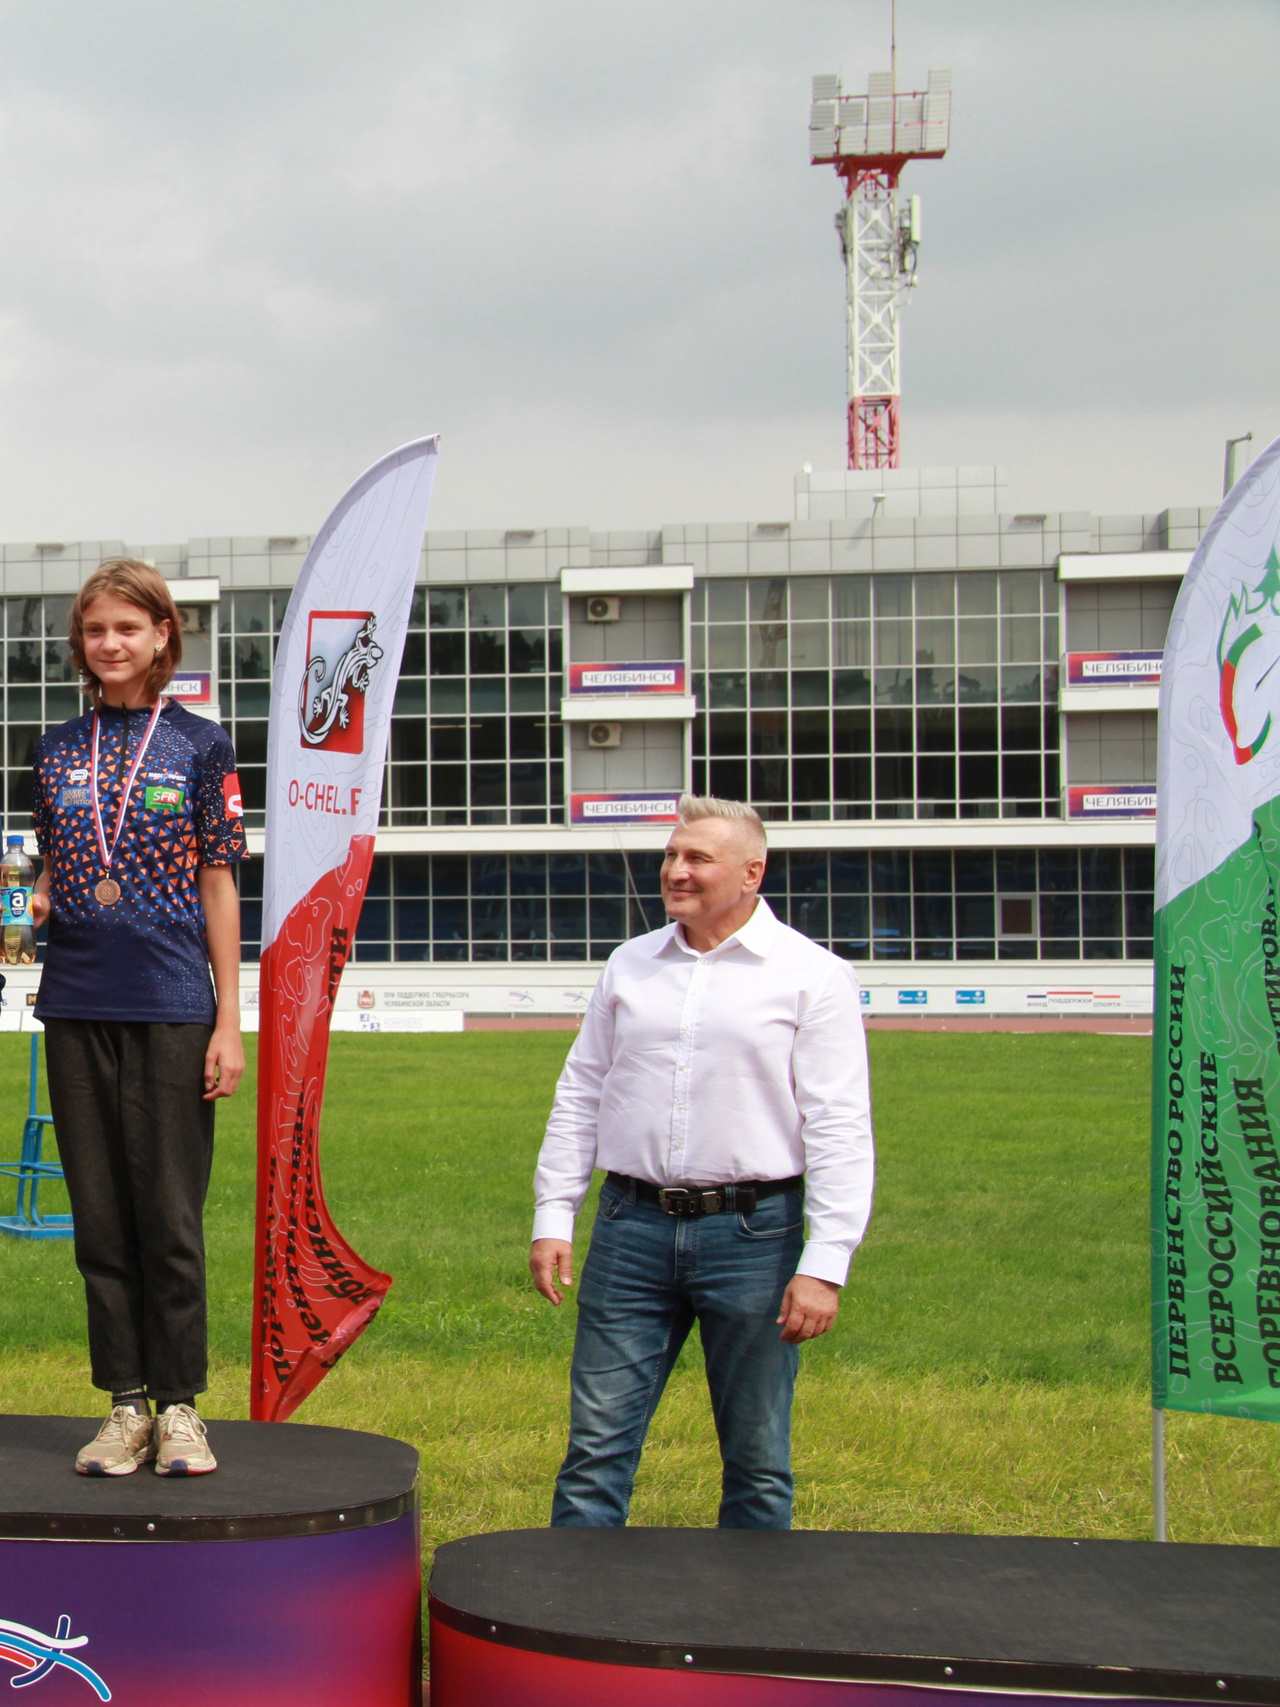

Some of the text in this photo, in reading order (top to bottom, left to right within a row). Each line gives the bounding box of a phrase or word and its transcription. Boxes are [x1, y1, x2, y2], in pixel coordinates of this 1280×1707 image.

[1085, 662, 1163, 673] ЧЕЛЯБИН
[584, 672, 672, 684] ЧЕЛЯБИНСК
[153, 790, 177, 803] SFR
[585, 802, 673, 814] ЧЕЛЯБИНСК
[1165, 963, 1191, 1379] ПЕРВЕНСТВО РОССИИ
[1195, 1052, 1244, 1385] ВСЕРОССИЙСКИЕ
